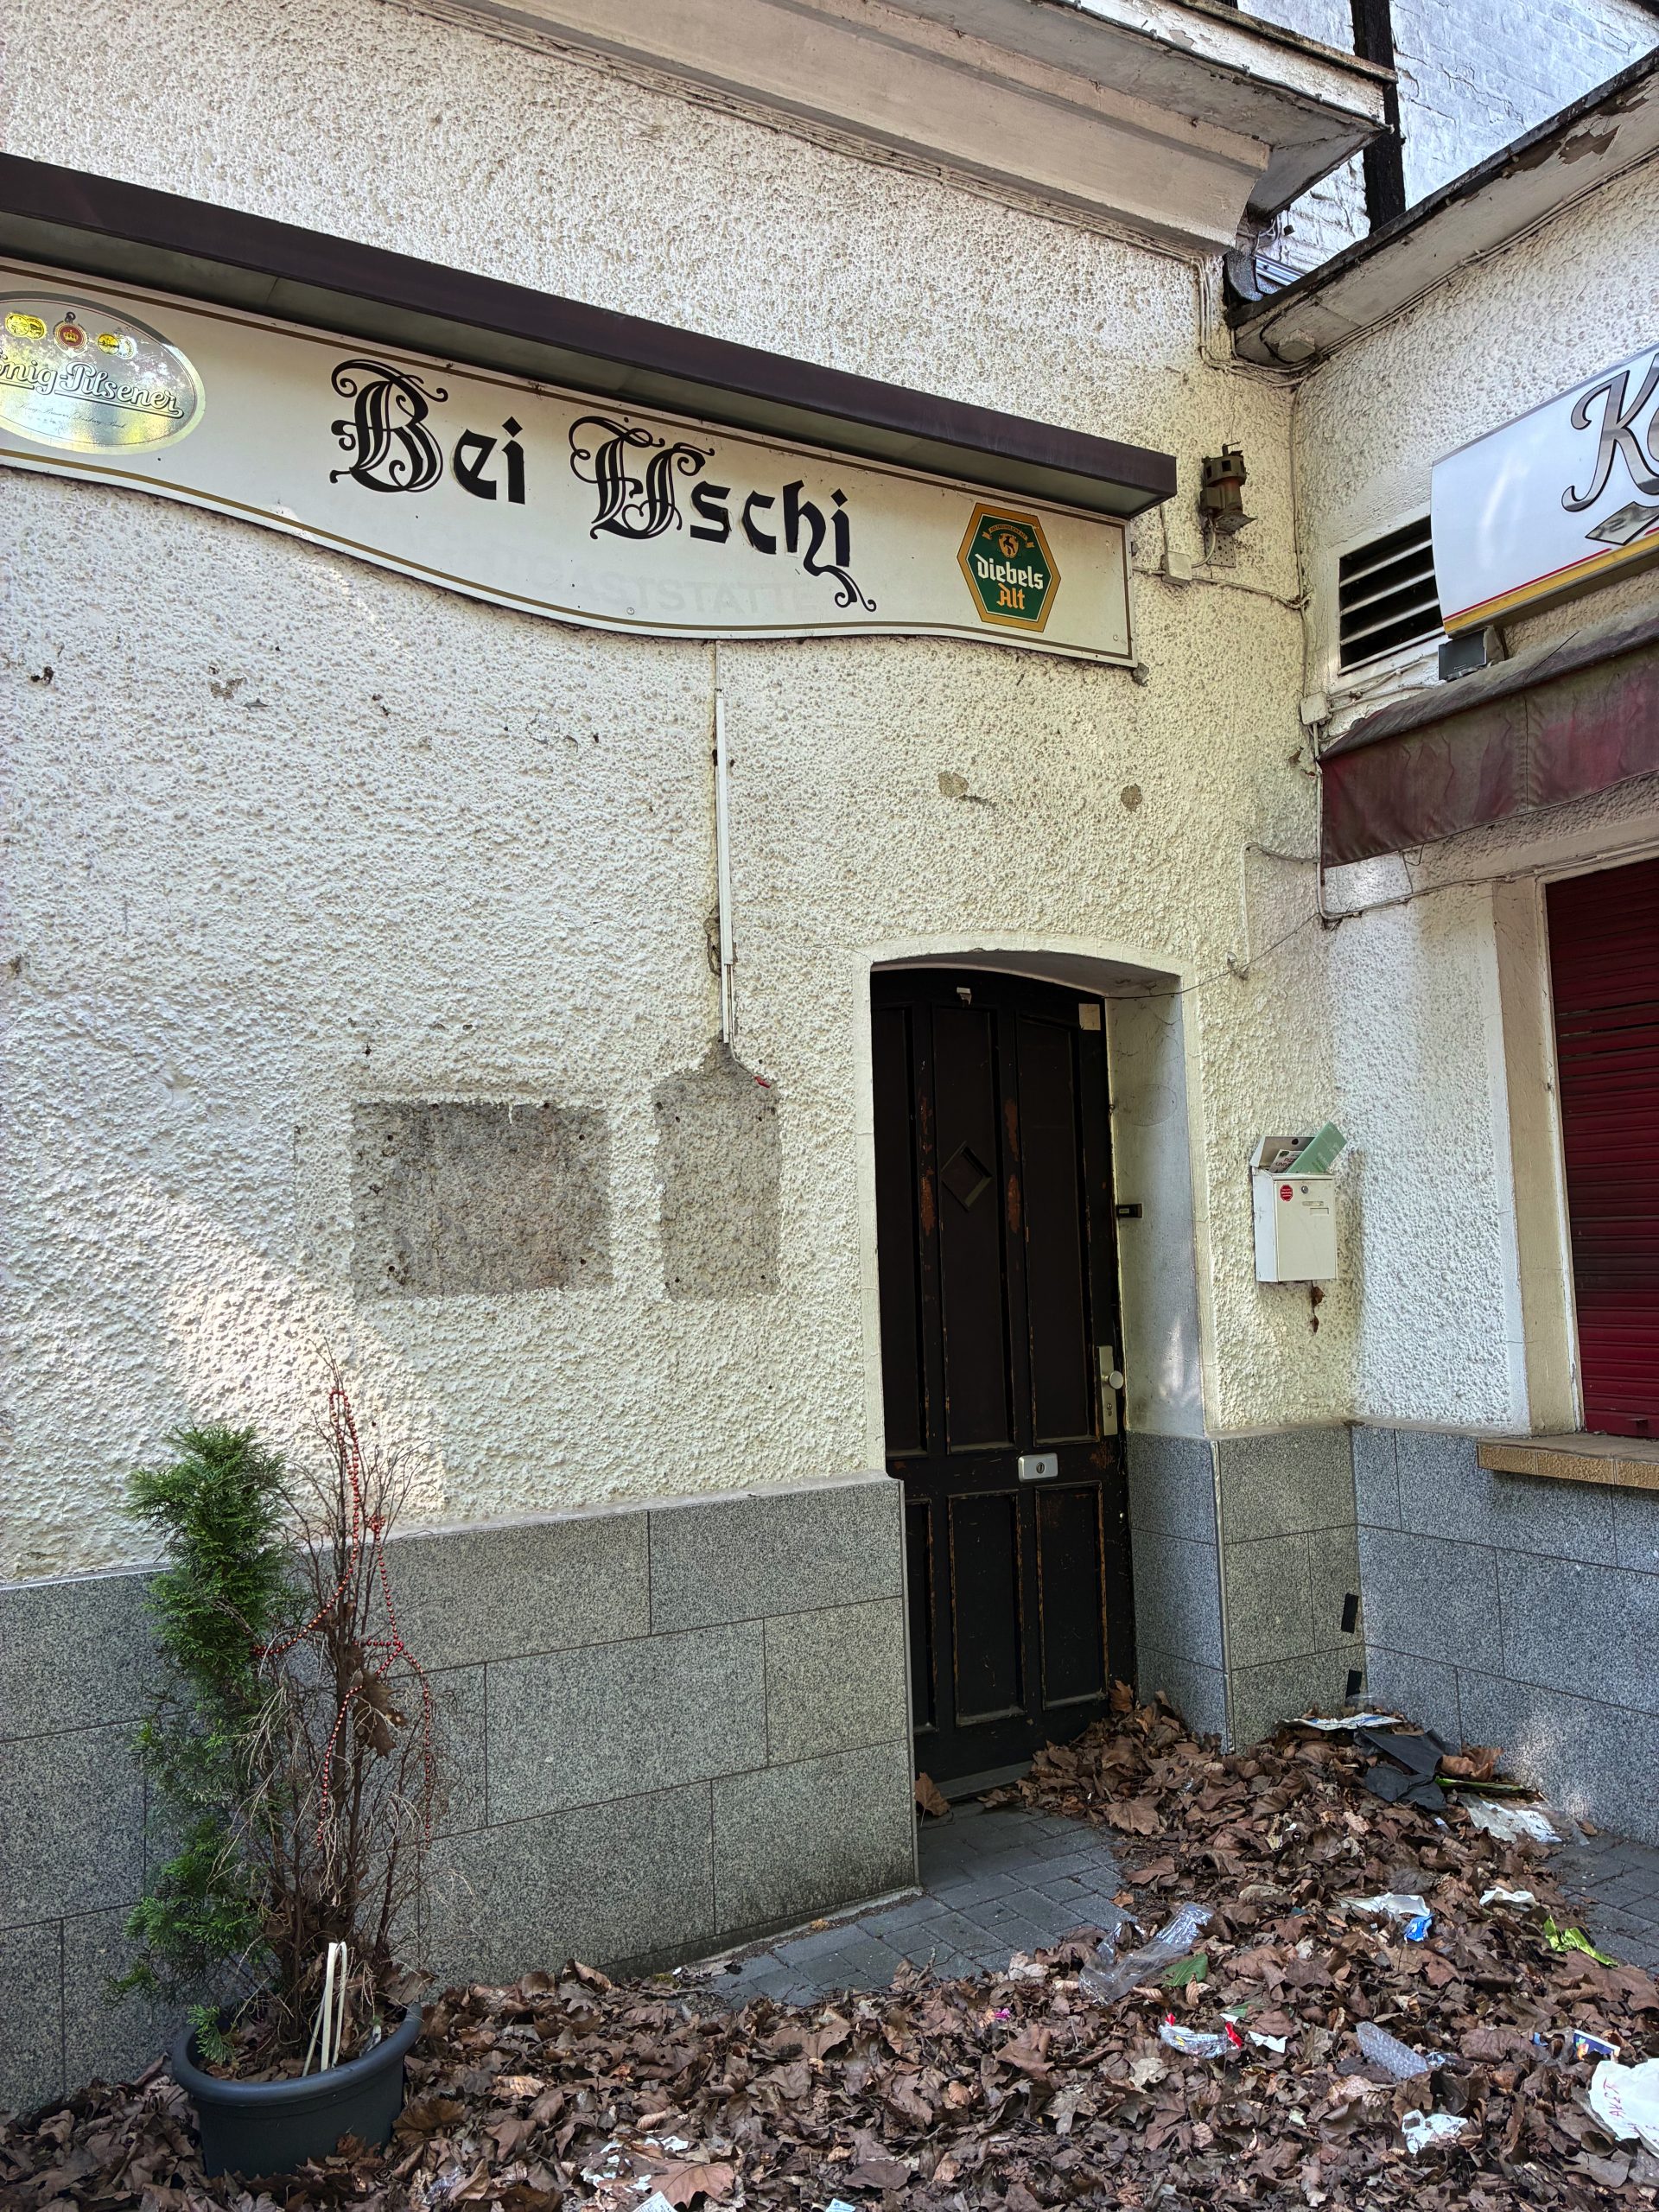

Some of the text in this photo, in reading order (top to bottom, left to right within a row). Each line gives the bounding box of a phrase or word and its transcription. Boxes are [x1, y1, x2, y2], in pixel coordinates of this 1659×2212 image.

[0, 347, 184, 418] nig-Pilsener
[1561, 353, 1659, 512] K
[329, 359, 876, 612] Bei Uschi
[996, 582, 1026, 610] Alt
